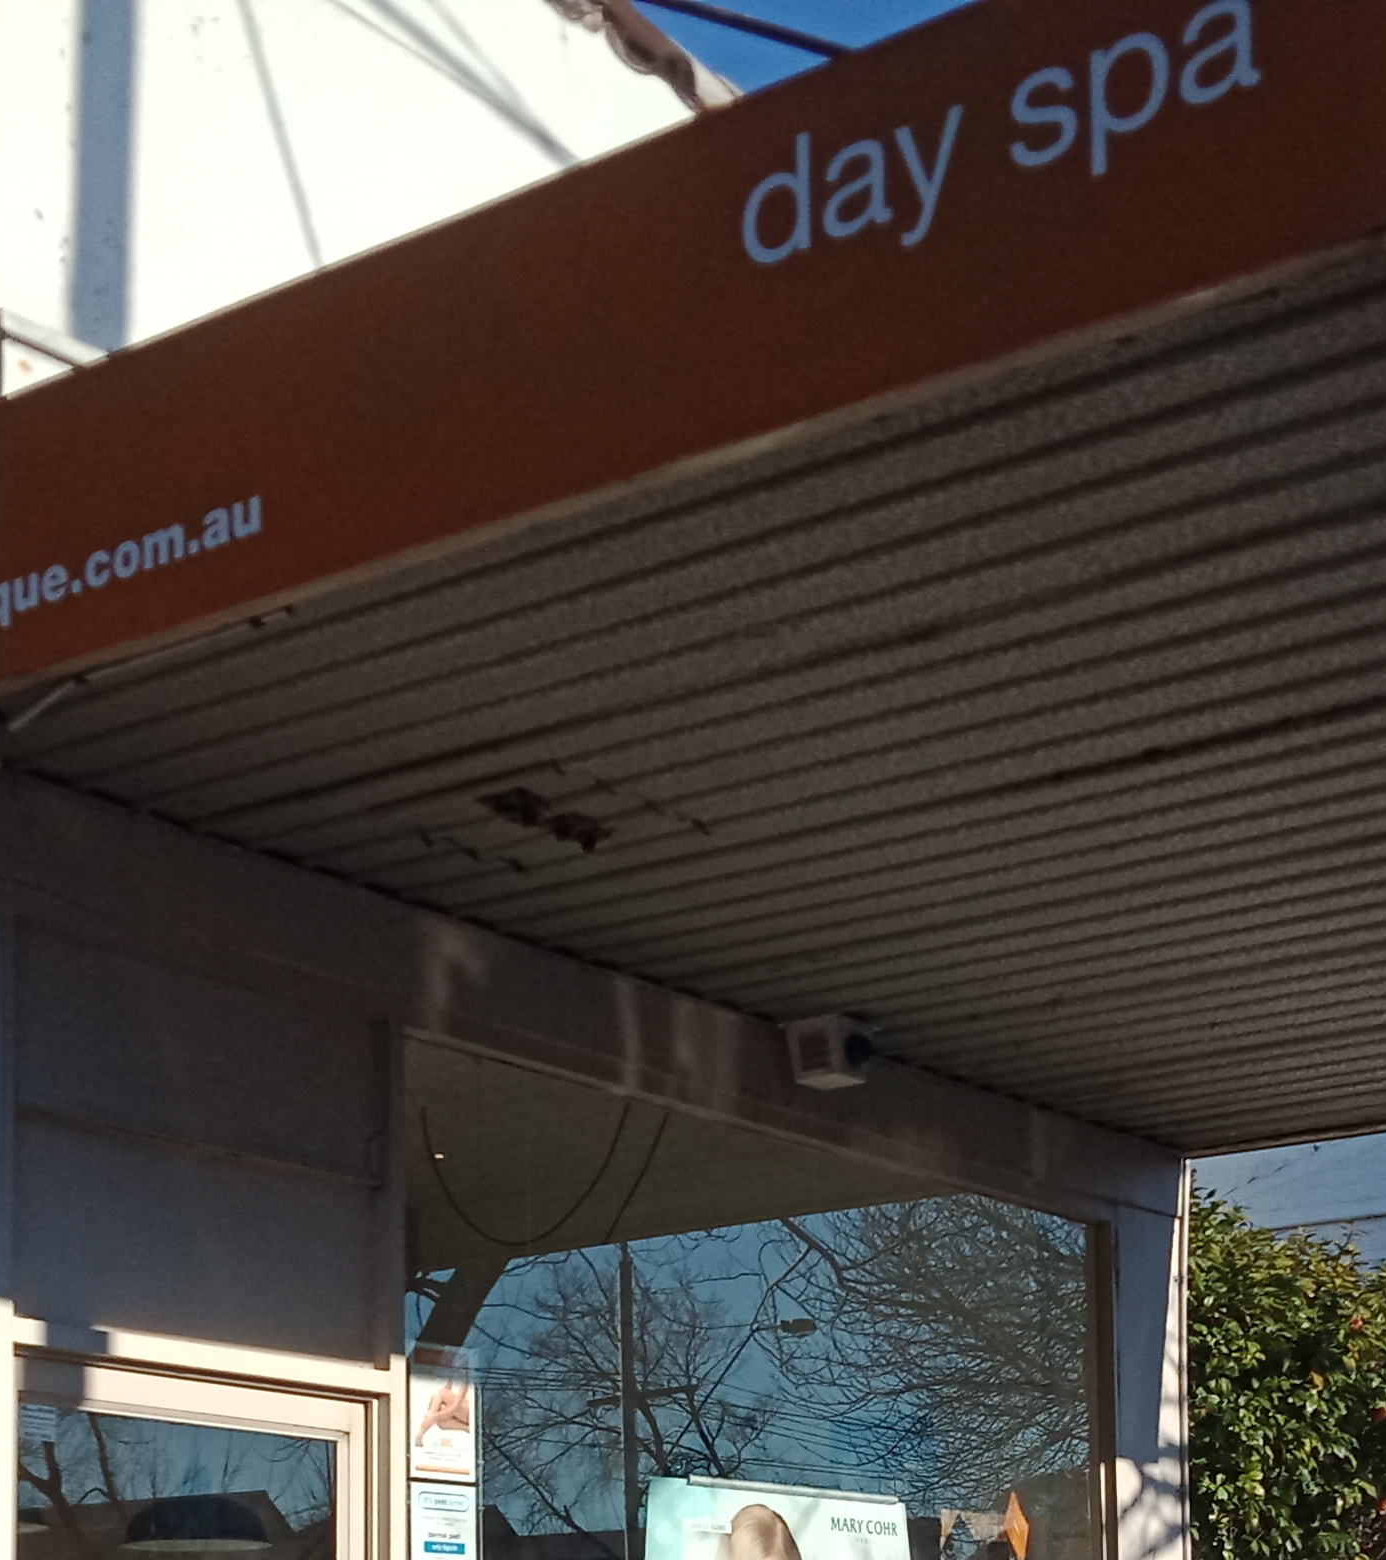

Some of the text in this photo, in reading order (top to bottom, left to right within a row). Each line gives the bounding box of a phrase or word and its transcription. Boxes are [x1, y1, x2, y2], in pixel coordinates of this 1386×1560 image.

[740, 0, 1262, 264] day spa
[830, 1516, 898, 1537] MARY COHR
